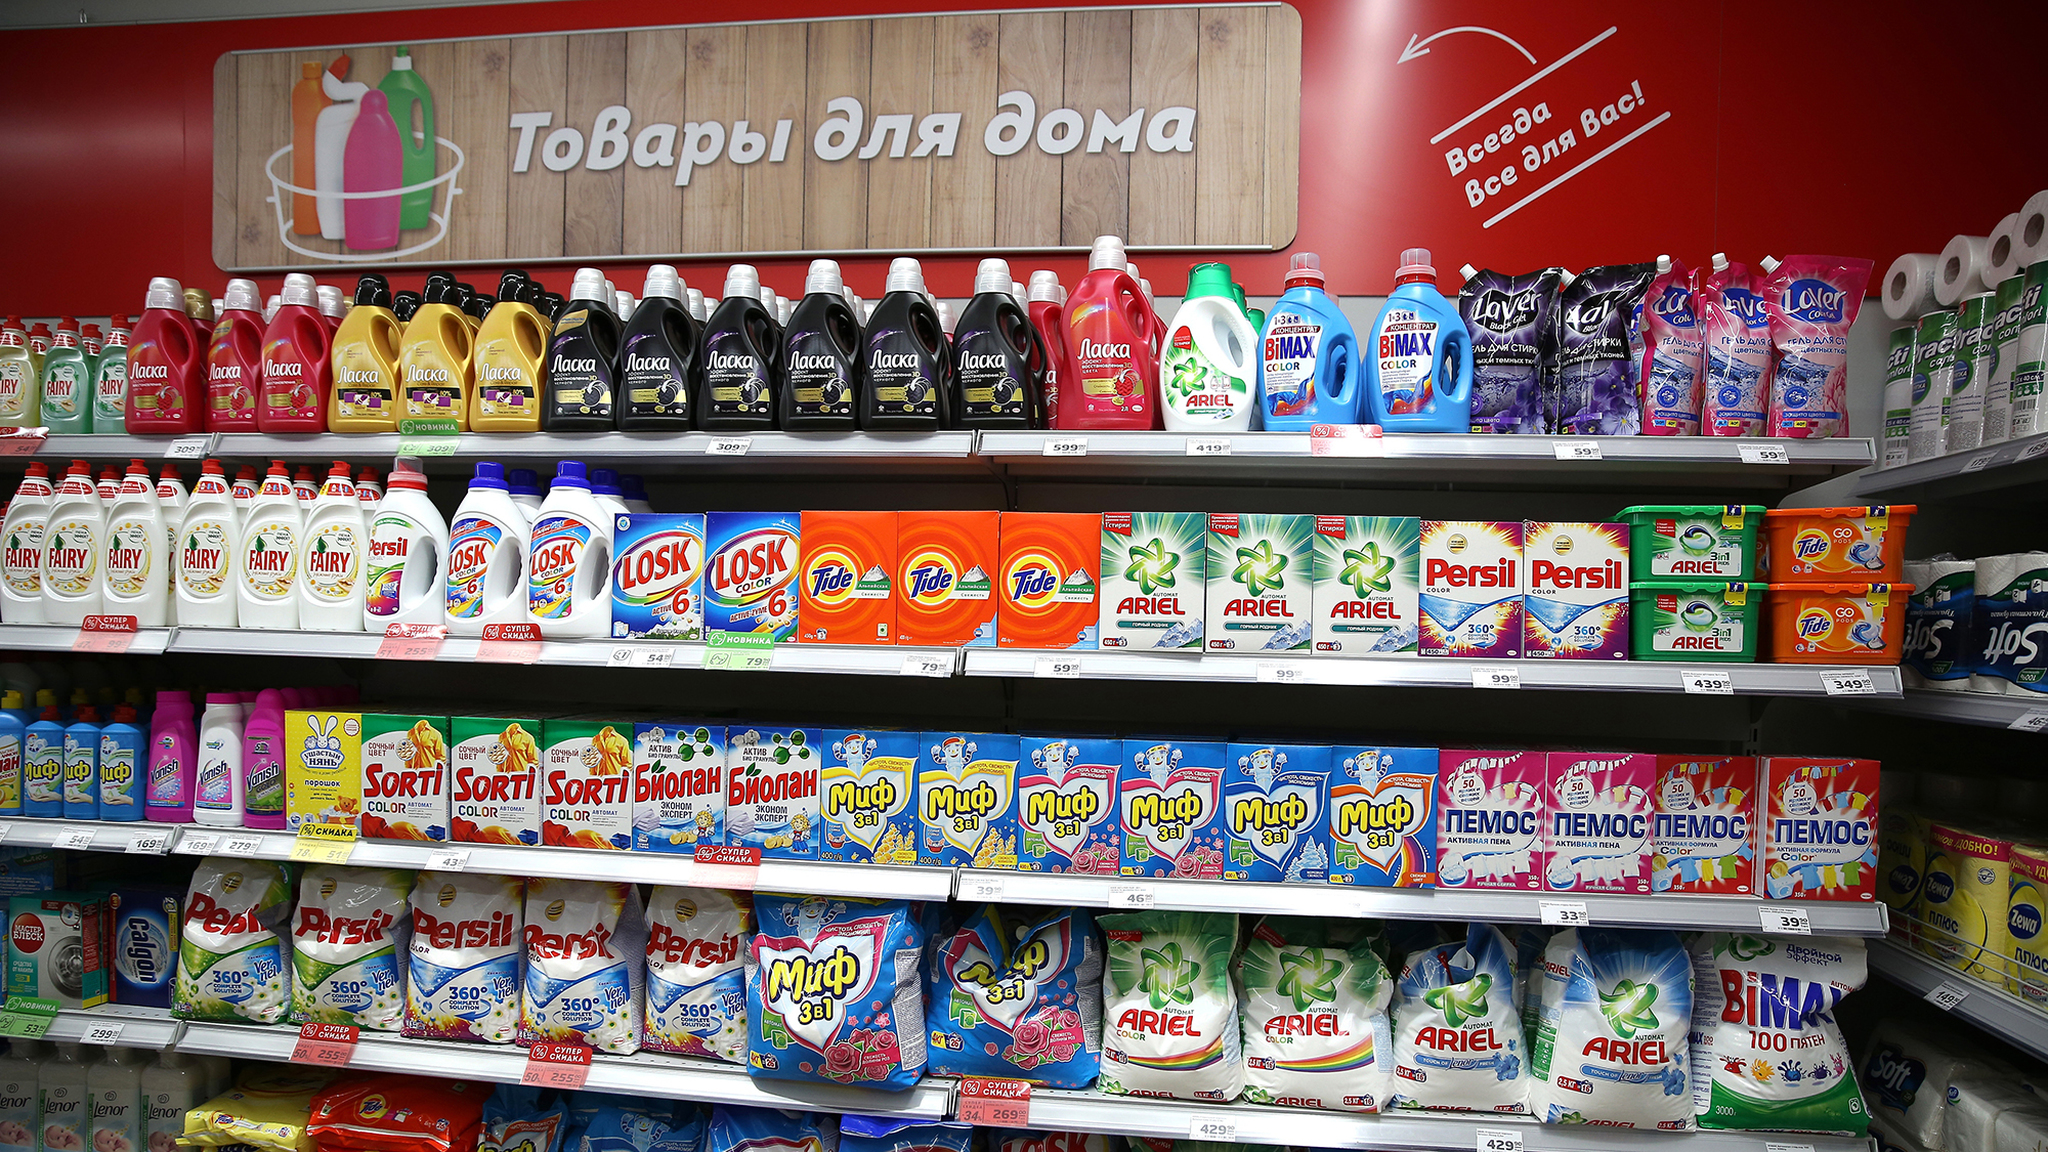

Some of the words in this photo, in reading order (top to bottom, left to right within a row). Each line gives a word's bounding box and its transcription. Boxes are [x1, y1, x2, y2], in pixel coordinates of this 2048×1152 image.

[508, 105, 794, 187] Товары
[813, 96, 962, 161] для
[983, 90, 1197, 157] дома
[1444, 102, 1552, 177] Всегда
[1521, 128, 1577, 172] для
[1782, 288, 1846, 314] Laver
[1275, 326, 1319, 334] КОНЦЕНТРАТ
[1390, 322, 1436, 332] КОНЦЕНТРАТ
[1265, 336, 1315, 361] BiMAX
[1380, 332, 1432, 358] BiMAX
[130, 362, 168, 379] Ласка
[209, 362, 241, 380] Ласка
[264, 359, 302, 378] Ласка
[1266, 362, 1300, 372] COLOR
[1381, 360, 1416, 370] COLOR
[338, 366, 379, 384] Ласка
[46, 380, 72, 396] FAIRY
[1186, 394, 1233, 407] ARIEL
[415, 422, 456, 432] НОВИНКА
[1832, 528, 1852, 539] GO
[368, 538, 408, 557] Persil
[1796, 536, 1828, 559] Tide
[5, 548, 41, 568] FAIRY
[49, 549, 87, 568] FAIRY
[108, 549, 142, 568] FAIRY
[448, 542, 487, 575] LOSK
[531, 542, 575, 576] LOSK
[622, 538, 692, 590] LOSK
[715, 535, 789, 591] LOSK
[455, 567, 477, 578] COLOR
[541, 567, 564, 577] COLOR
[1426, 557, 1515, 588] Persil
[1532, 559, 1621, 589] Persil
[810, 566, 853, 597] Tide
[908, 567, 953, 597] Tide
[1012, 568, 1056, 600] Tide
[652, 605, 672, 617] ACTIVE
[1116, 597, 1185, 615] ARIEL
[1224, 599, 1294, 617] ARIEL
[1330, 600, 1401, 619] ARIEL
[1836, 607, 1854, 618] GO
[103, 617, 129, 625] СУПЕР
[1468, 624, 1494, 635] 360°
[1574, 626, 1601, 637] 360°
[726, 635, 771, 645] НОВИНКА
[1672, 636, 1724, 649] ARIEL
[1983, 622, 2048, 665] Soft
[368, 742, 396, 751] СОЧНЫЙ
[368, 749, 387, 757] ЦВЕТ
[458, 745, 486, 754] СОЧНЫЙ
[551, 748, 579, 758] СОЧНЫЙ
[649, 744, 672, 753] АКТИВ
[743, 748, 767, 756] АКТИВ
[309, 757, 338, 769] НЯНЬ
[458, 753, 477, 761] ЦВЕТ
[551, 756, 570, 764] ЦВЕТ
[150, 758, 180, 782] Vanish
[304, 779, 341, 788] порошок
[363, 763, 442, 799] SORTI
[454, 766, 535, 802] SORTI
[636, 761, 722, 802] Биолан
[729, 765, 817, 807] Биолан
[1462, 779, 1474, 789] 50
[1572, 782, 1583, 792] 50
[545, 770, 630, 806] SORTI
[1672, 784, 1684, 794] 50
[1793, 788, 1806, 798] 50
[830, 777, 896, 814] Миф
[928, 781, 995, 820] Миф
[660, 802, 692, 811] ЭКОНОМ
[756, 805, 788, 814] ЭКОНОМ
[660, 809, 693, 819] ЭКСПЕРТ
[754, 813, 788, 822] ЭКСПЕРТ
[1446, 808, 1536, 835] ПЕМОС
[1554, 812, 1646, 839] ПЕМОС
[1655, 814, 1746, 839] ПЕМОС
[316, 827, 353, 838] СКИДКА
[1776, 819, 1869, 845] ПЕМОС
[1447, 837, 1489, 845] АКТИВНАЯ
[1490, 838, 1511, 846] ПЕНА
[1555, 840, 1598, 849] АКТИВНАЯ
[1599, 841, 1620, 849] ПЕНА
[1656, 840, 1688, 848] АКТИВНАЯ
[721, 848, 750, 856] СУПЕР
[1660, 846, 1693, 856] Color
[1781, 852, 1815, 862] Color
[716, 854, 752, 863] СКИДКА
[1927, 876, 1951, 899] Zewa
[1929, 911, 1959, 933] ПЛЮС
[2011, 910, 2038, 935] Zewa
[15, 925, 42, 933] МАСТЕР
[13, 932, 43, 941] БЛЕСК
[128, 918, 157, 983] Calgon
[1785, 943, 1842, 964] Двойной
[213, 971, 249, 984] 360°
[372, 969, 390, 982] Ver
[331, 981, 367, 994] 360°
[20, 1002, 57, 1012] НОВИНКА
[1748, 1029, 1787, 1053] 100
[1790, 1033, 1826, 1051] ПЯТЕН
[45, 1101, 80, 1114] Lenor
